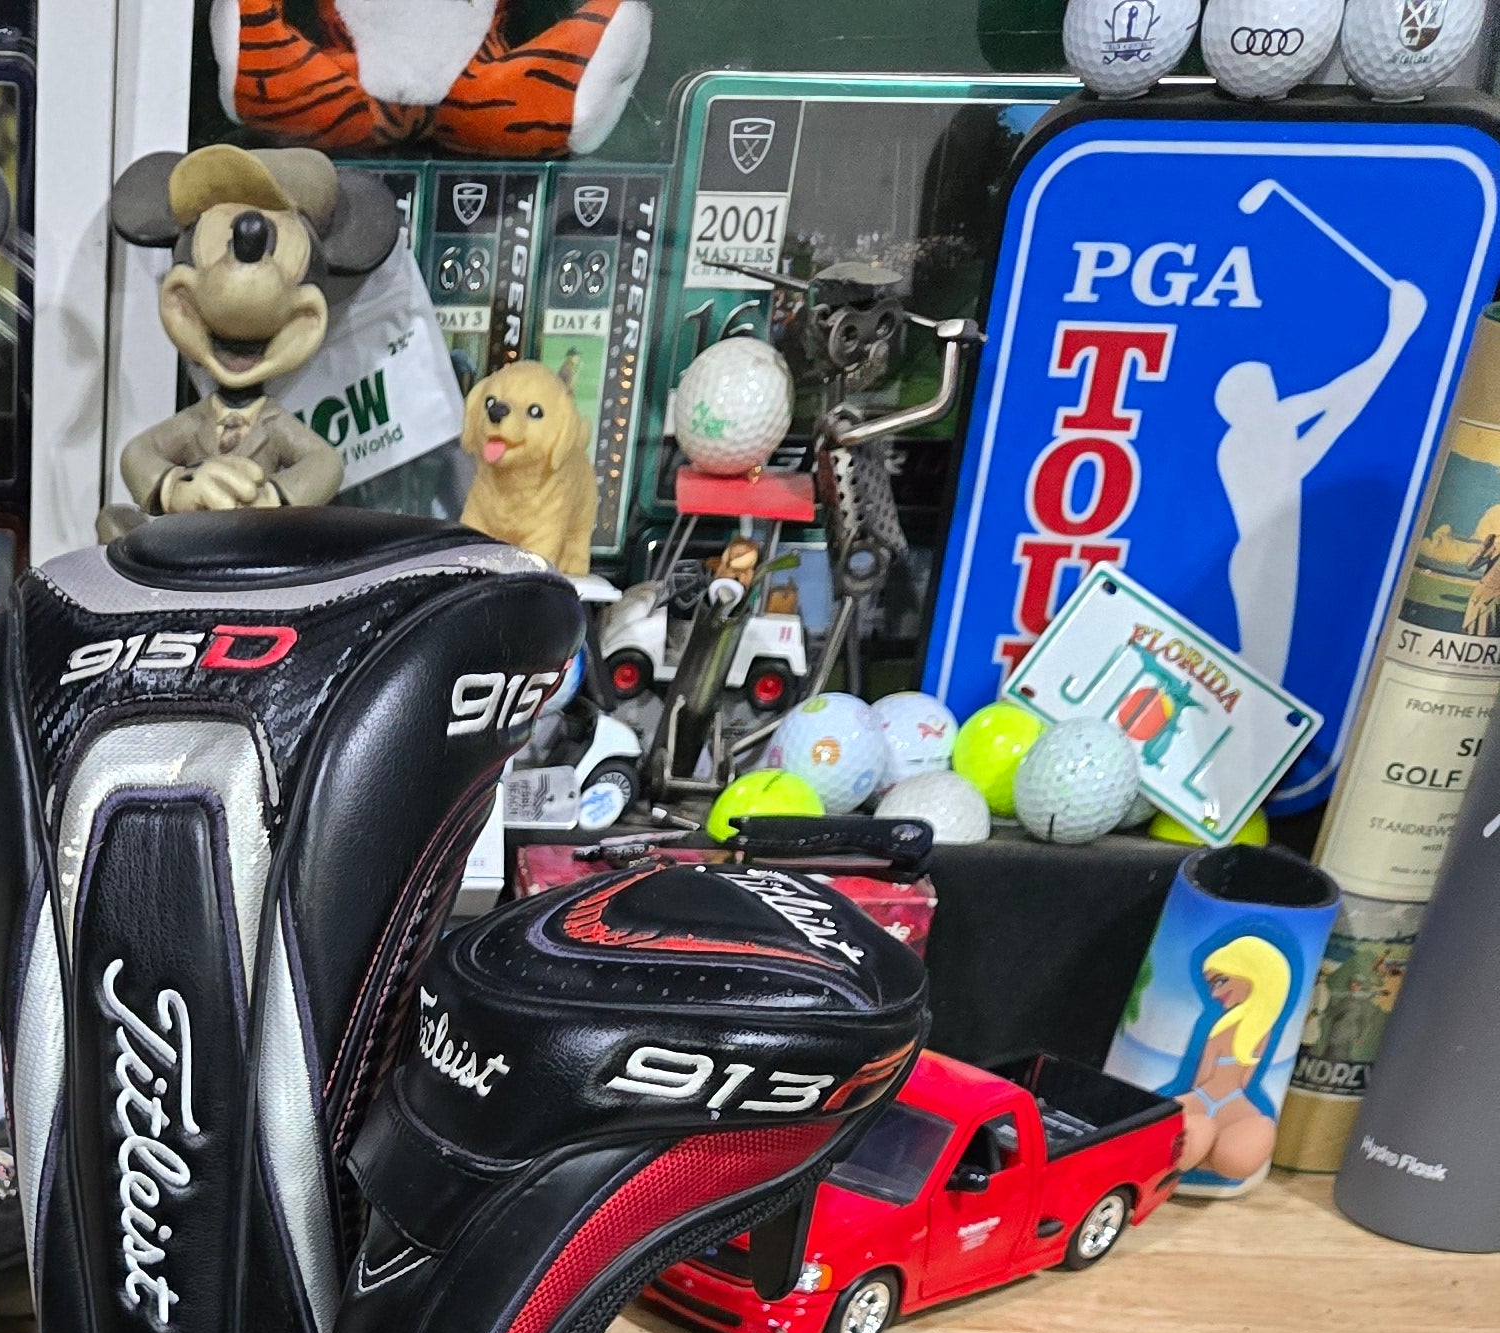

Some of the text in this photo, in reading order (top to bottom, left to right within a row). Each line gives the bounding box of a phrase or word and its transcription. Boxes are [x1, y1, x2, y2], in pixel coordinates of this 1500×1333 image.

[696, 204, 779, 243] 2001
[439, 246, 491, 293] 68
[558, 249, 611, 295] 68
[624, 195, 656, 349] TIGER
[693, 246, 776, 263] MASTERS
[1063, 241, 1262, 308] PGA
[436, 311, 467, 327] DAY
[552, 313, 602, 330] DAY 4
[353, 423, 404, 461] World
[1000, 320, 1178, 692] TOU
[60, 624, 298, 686] 915D
[1128, 623, 1244, 714] FLORIDA
[1398, 629, 1500, 664] ST. ANDR
[447, 671, 560, 736] 915
[1405, 698, 1444, 718] FROM
[1446, 704, 1477, 719] THE
[1384, 762, 1463, 788] GOLF
[101, 957, 203, 1333] Titleist
[1360, 1134, 1449, 1182] Hydro Flask
